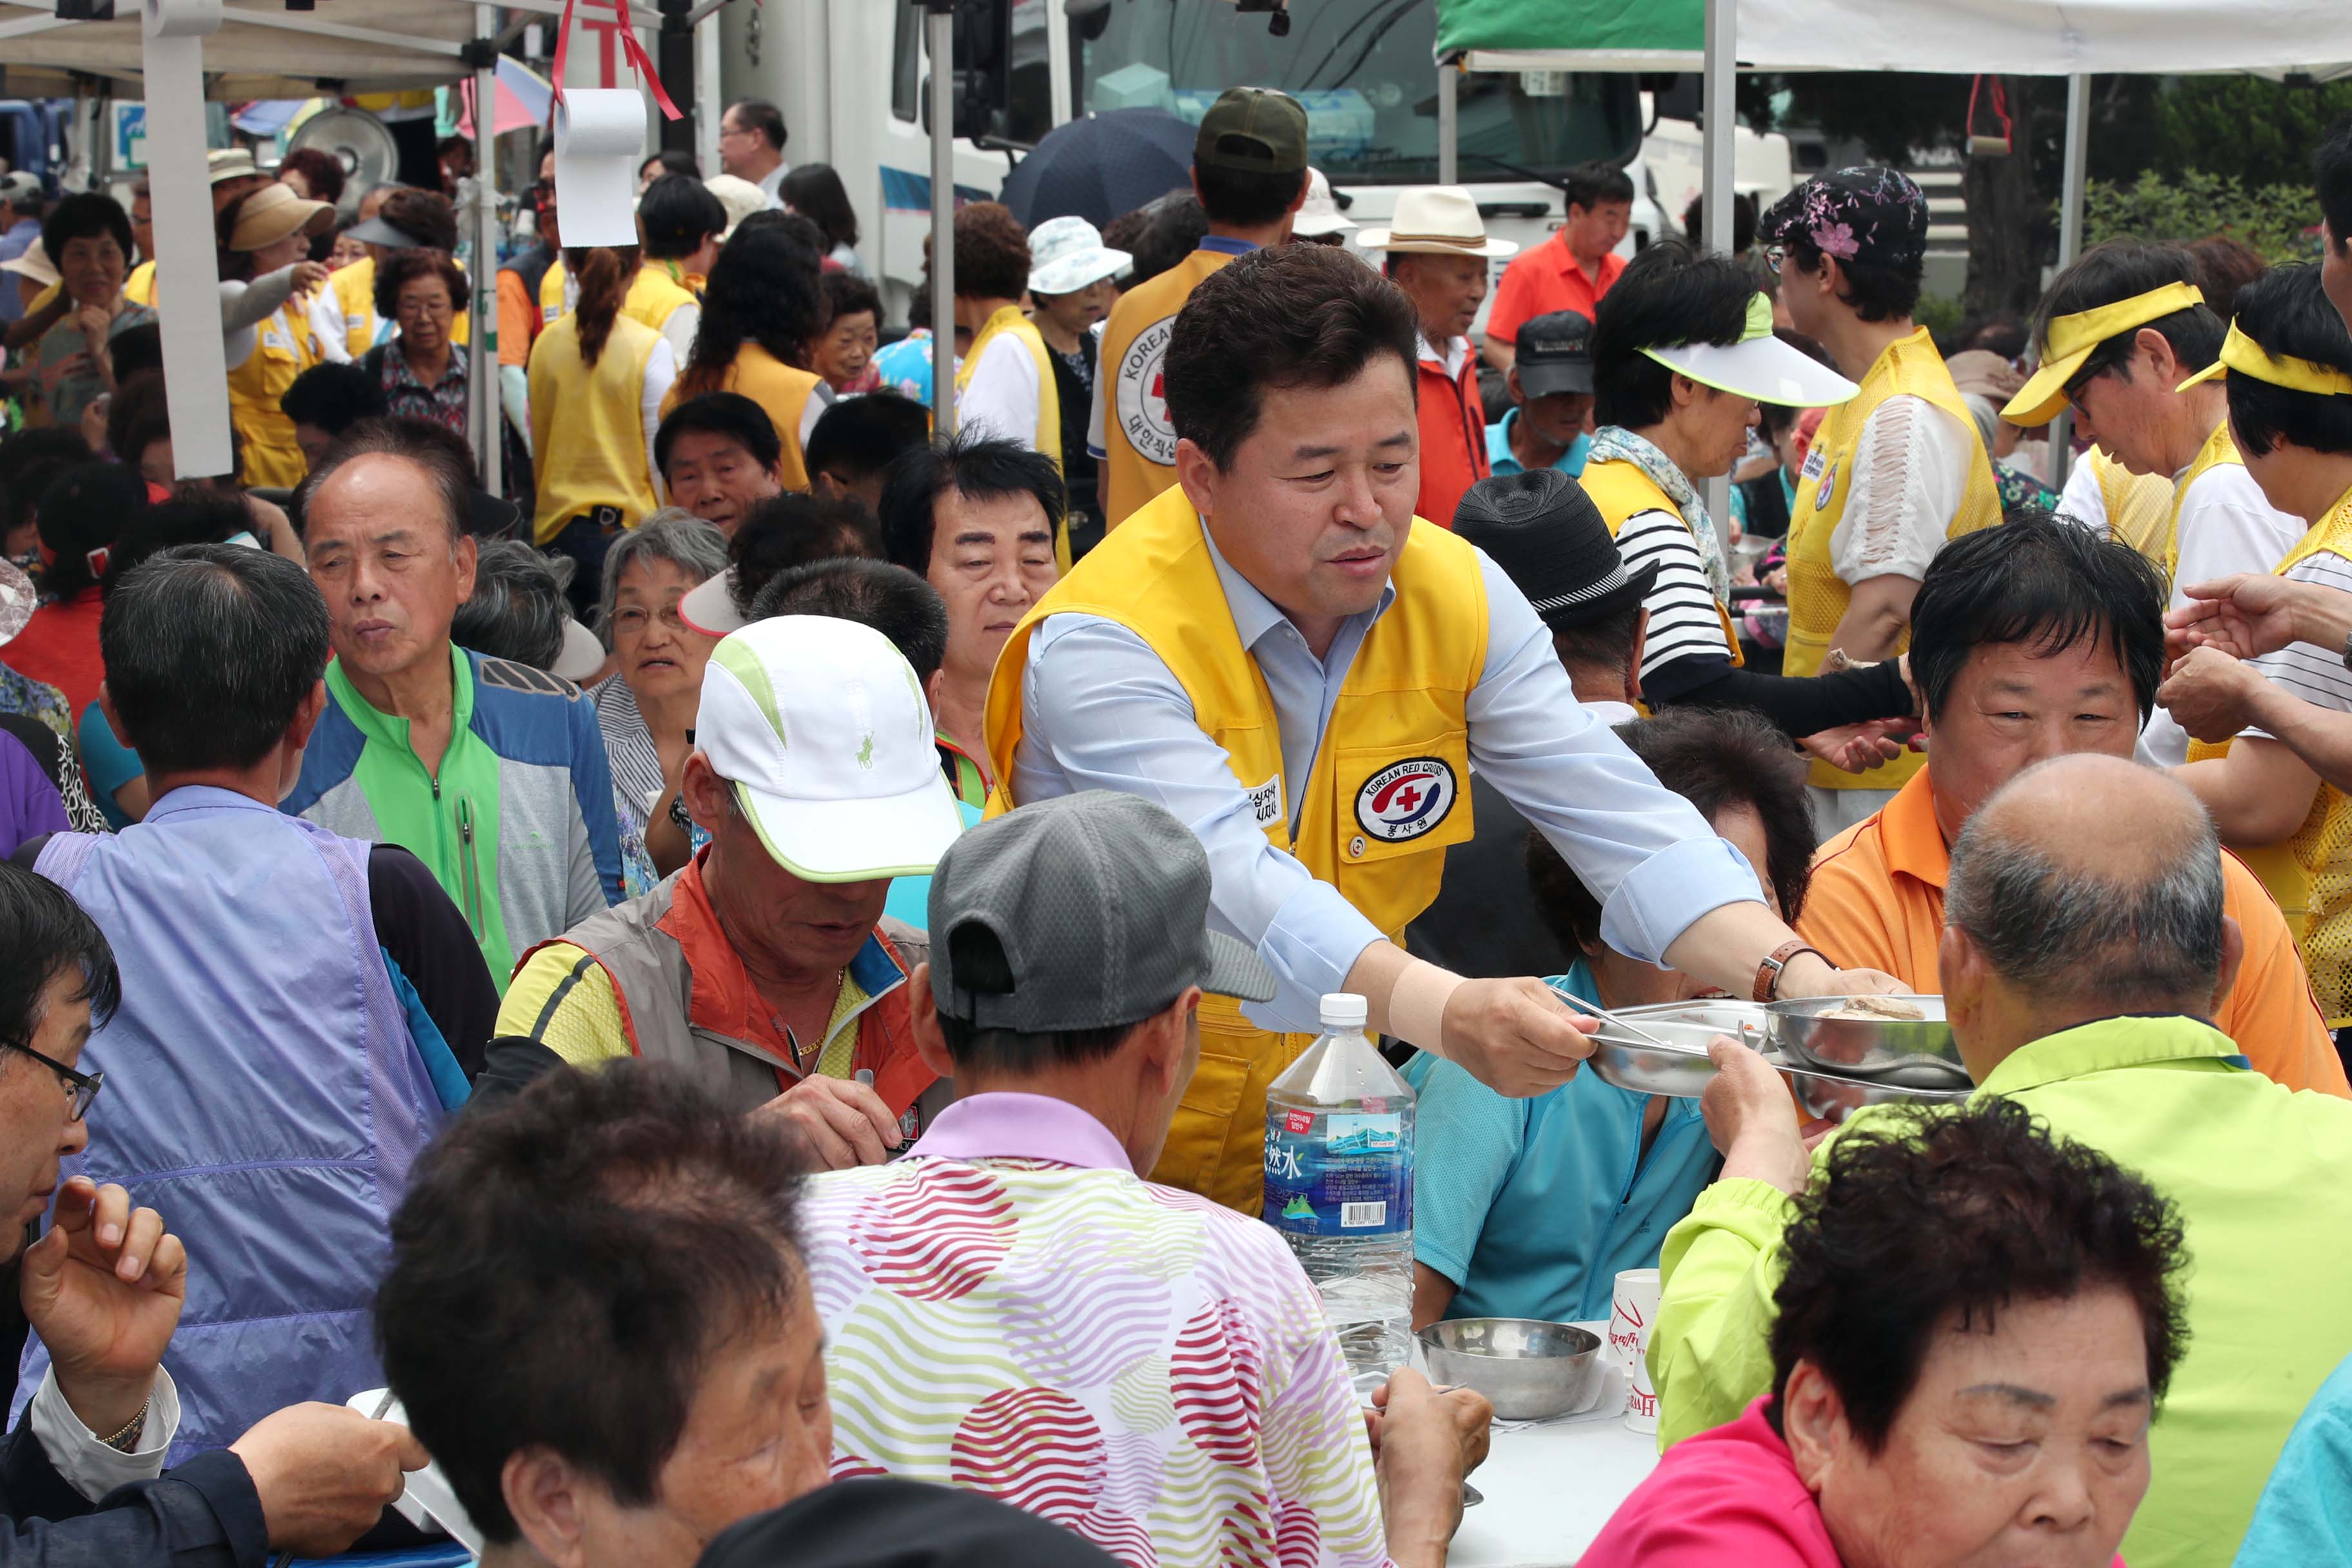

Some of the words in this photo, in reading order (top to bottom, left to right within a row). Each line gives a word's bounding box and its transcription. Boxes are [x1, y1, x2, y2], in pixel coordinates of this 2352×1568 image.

[1365, 768, 1400, 796] KOREAN
[1402, 763, 1420, 774] RED
[1422, 763, 1444, 776] CROSS
[1249, 783, 1276, 807] 십자사
